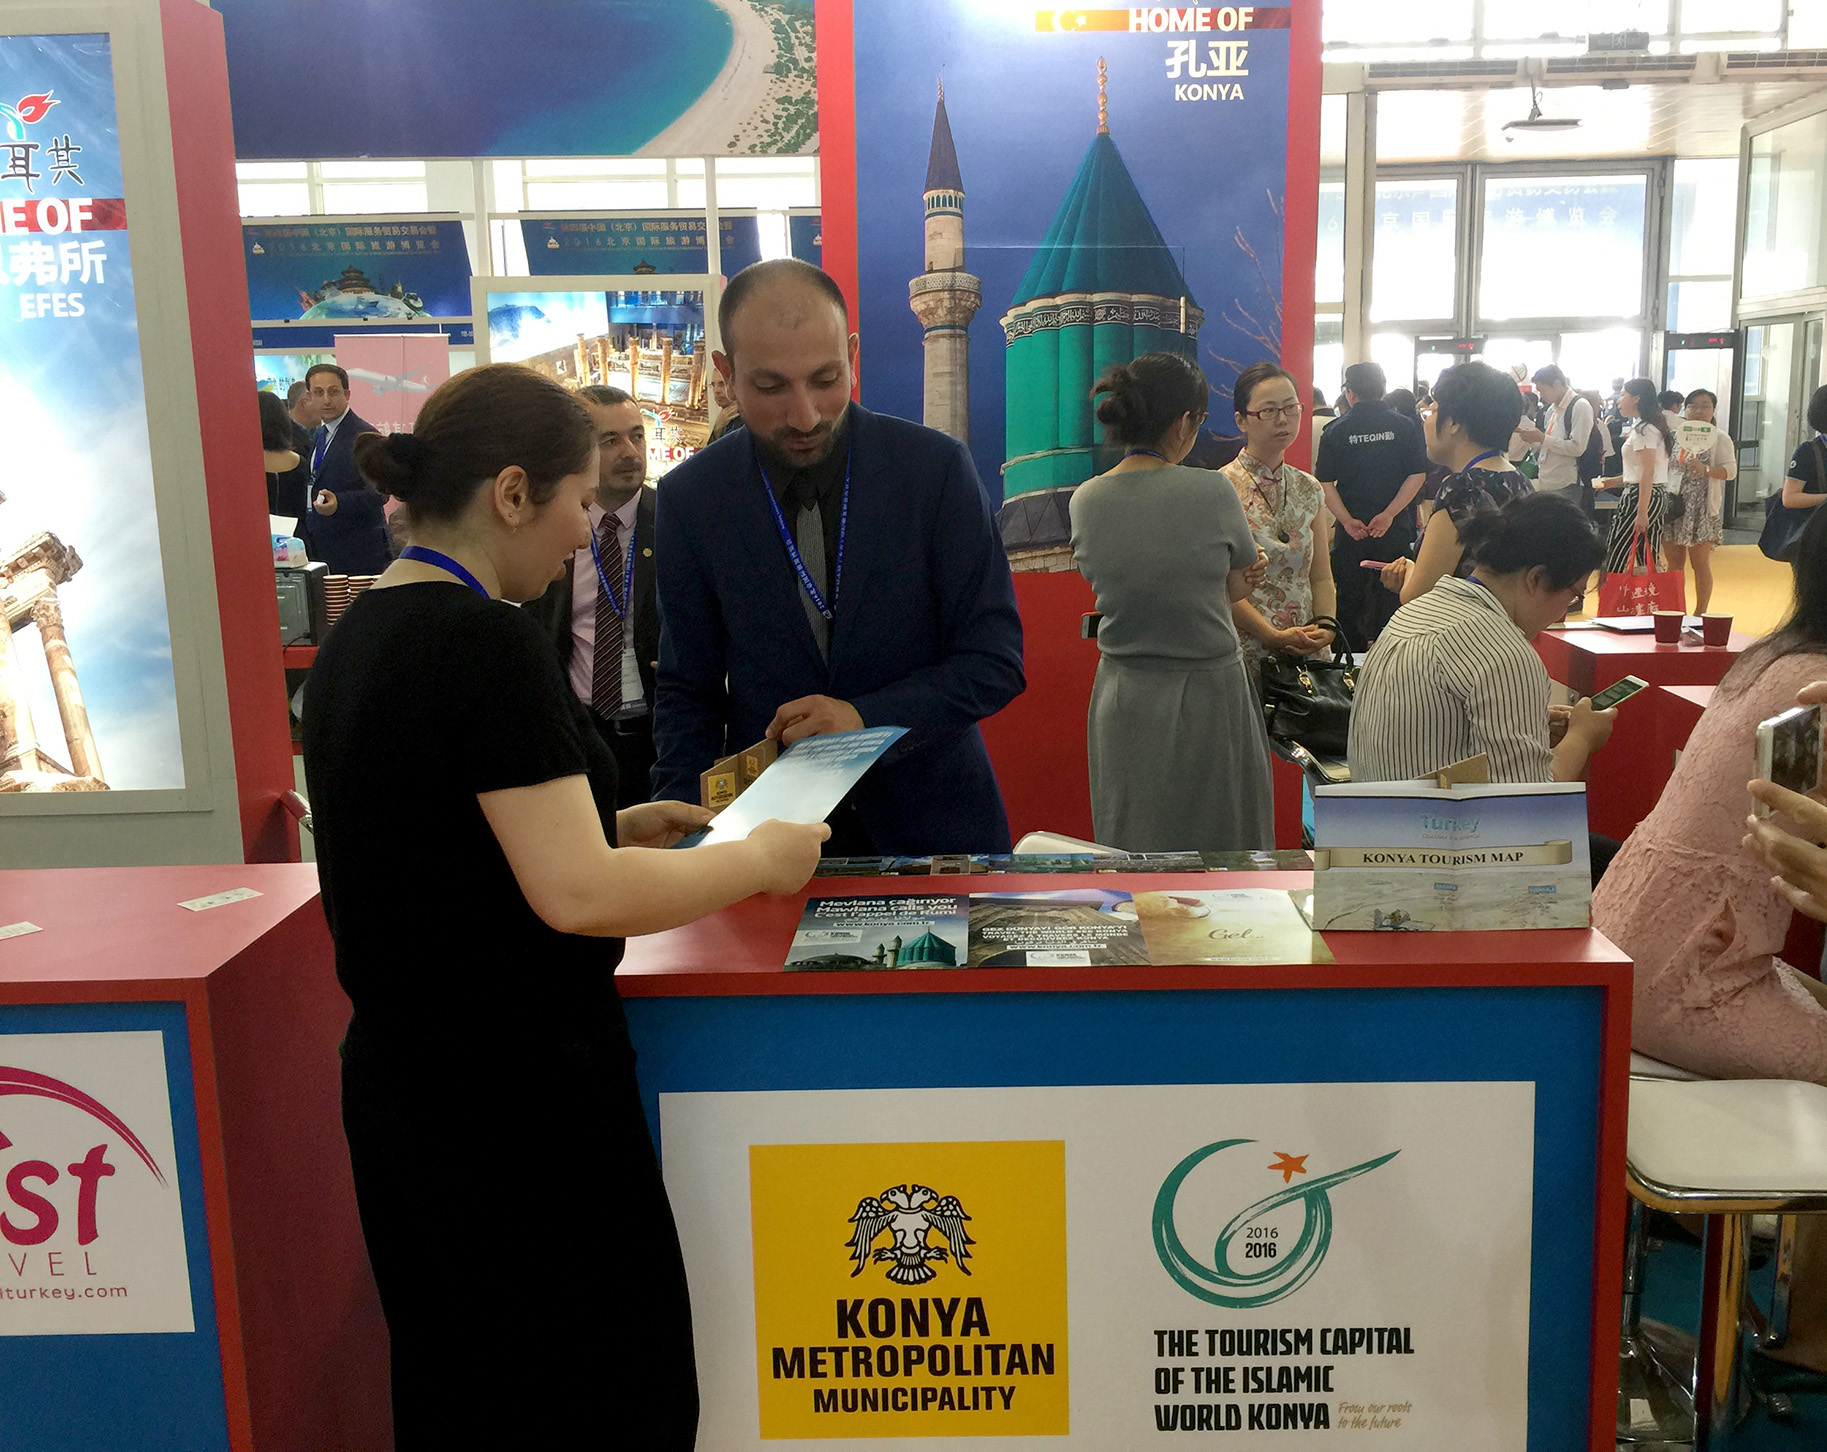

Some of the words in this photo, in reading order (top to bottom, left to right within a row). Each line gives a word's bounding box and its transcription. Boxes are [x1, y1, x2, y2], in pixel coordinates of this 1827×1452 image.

[1129, 7, 1211, 32] HOME
[1217, 7, 1254, 32] OF
[1165, 39, 1249, 79] 孔亚
[1175, 84, 1245, 101] KONYA
[36, 197, 93, 236] OF
[20, 292, 86, 319] EFES
[1363, 853, 1416, 864] KONYA
[1418, 854, 1486, 866] TOURISM
[1490, 852, 1524, 862] MAP
[820, 900, 886, 908] Mevlana
[890, 904, 925, 912] calls
[1246, 1227, 1279, 1239] 2016
[1245, 1242, 1277, 1258] 2016
[836, 1297, 990, 1339] KONYA
[1154, 1330, 1199, 1357] THE
[1205, 1328, 1313, 1356] TOURISM
[1320, 1327, 1415, 1355] CAPITAL
[772, 1343, 1055, 1379] METROPOLITAN
[1155, 1367, 1185, 1394] OF
[1191, 1366, 1236, 1394] THE
[1242, 1365, 1335, 1393] ISLAMIC
[813, 1386, 1016, 1413] MUNICIPALITY
[1338, 1401, 1364, 1414] From
[1367, 1403, 1386, 1414] our
[1387, 1401, 1413, 1413] roots
[1154, 1404, 1242, 1431] WORLD
[1248, 1402, 1331, 1431] KONYA
[1338, 1417, 1349, 1429] to
[1350, 1414, 1368, 1429] the
[1369, 1415, 1402, 1431] future
